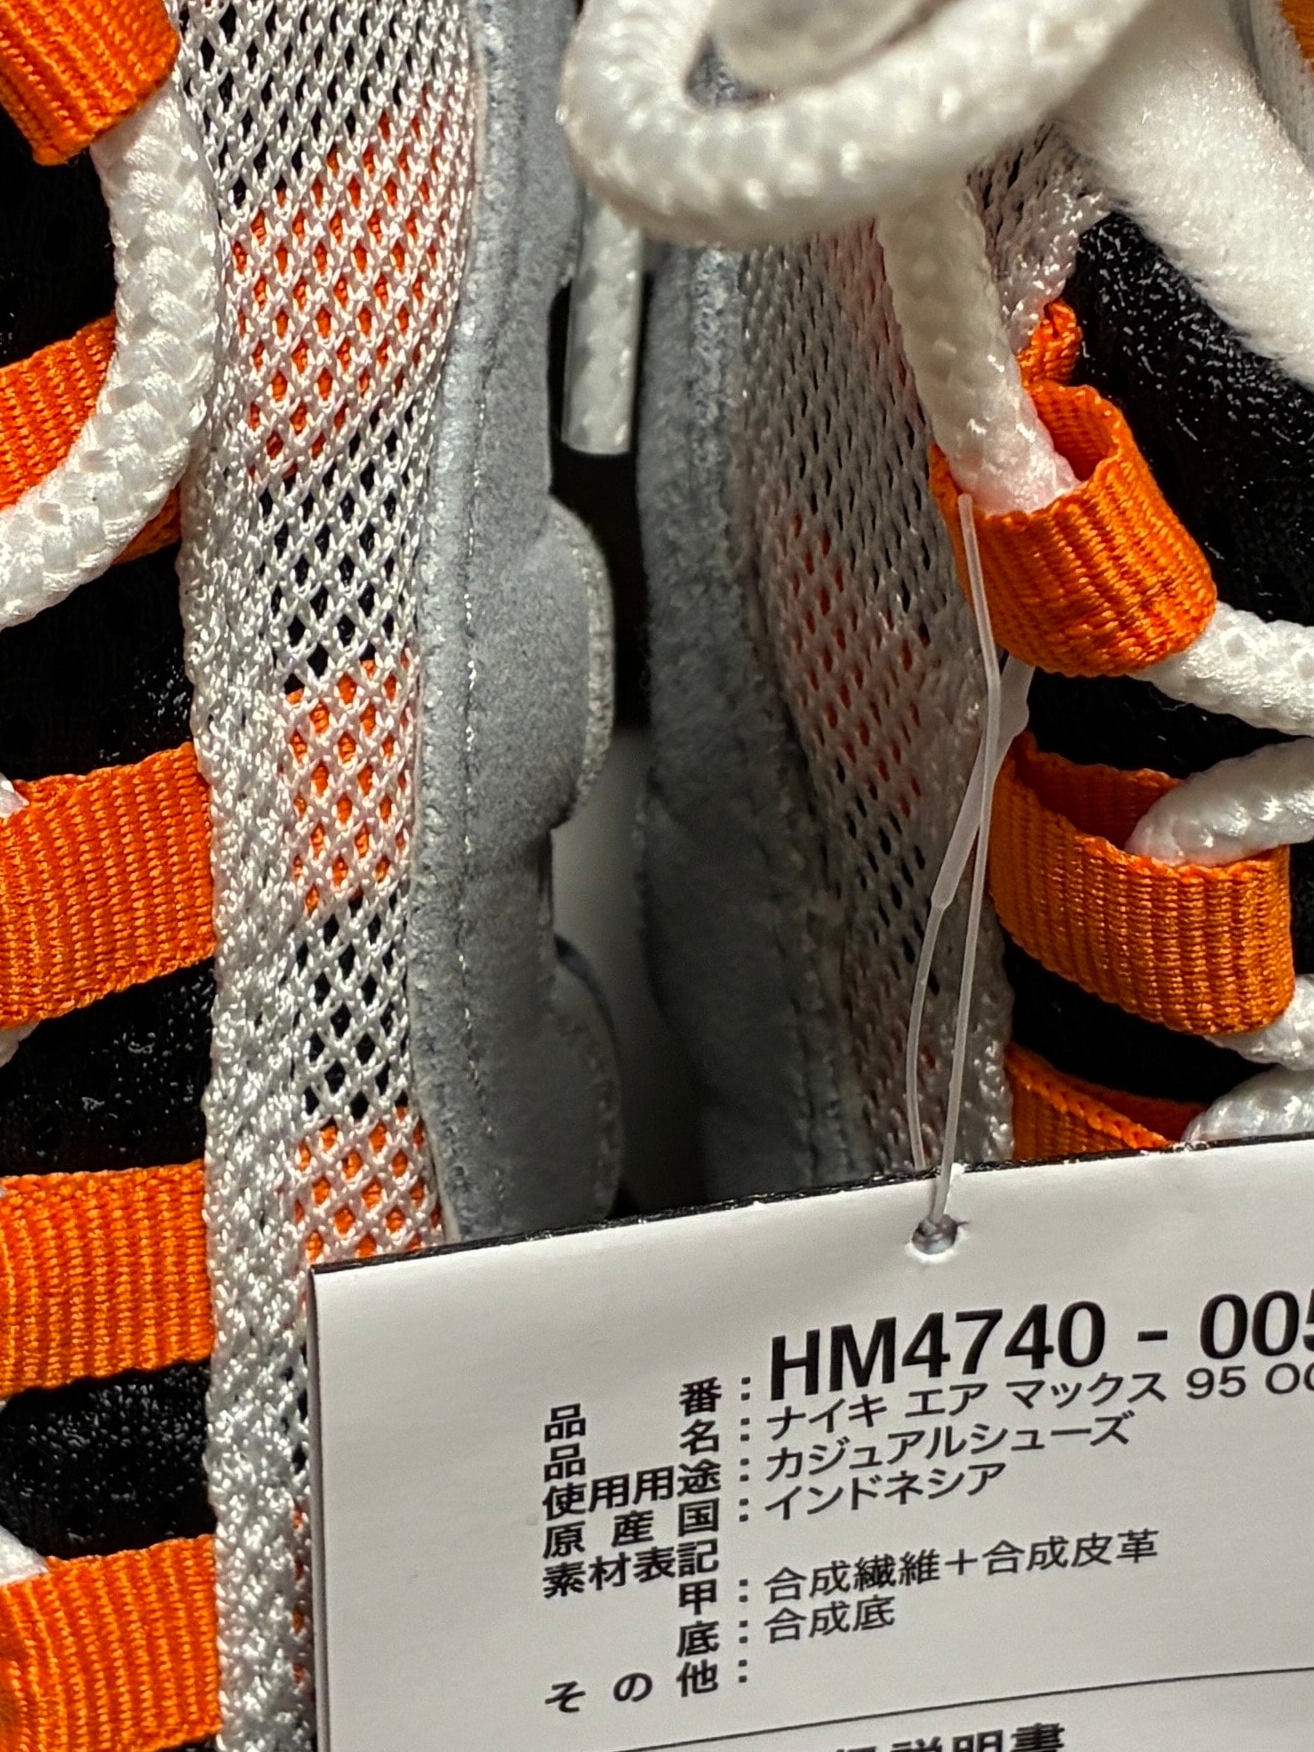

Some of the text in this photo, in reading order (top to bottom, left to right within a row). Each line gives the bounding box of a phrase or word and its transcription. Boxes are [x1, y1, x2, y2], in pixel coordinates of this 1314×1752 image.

[771, 1301, 1106, 1401] HM4740
[766, 1410, 1135, 1481] カジュアルシューズ
[765, 1462, 1006, 1520] インドネシア
[543, 1538, 719, 1599] 素材表記
[764, 1594, 896, 1644] 合成底
